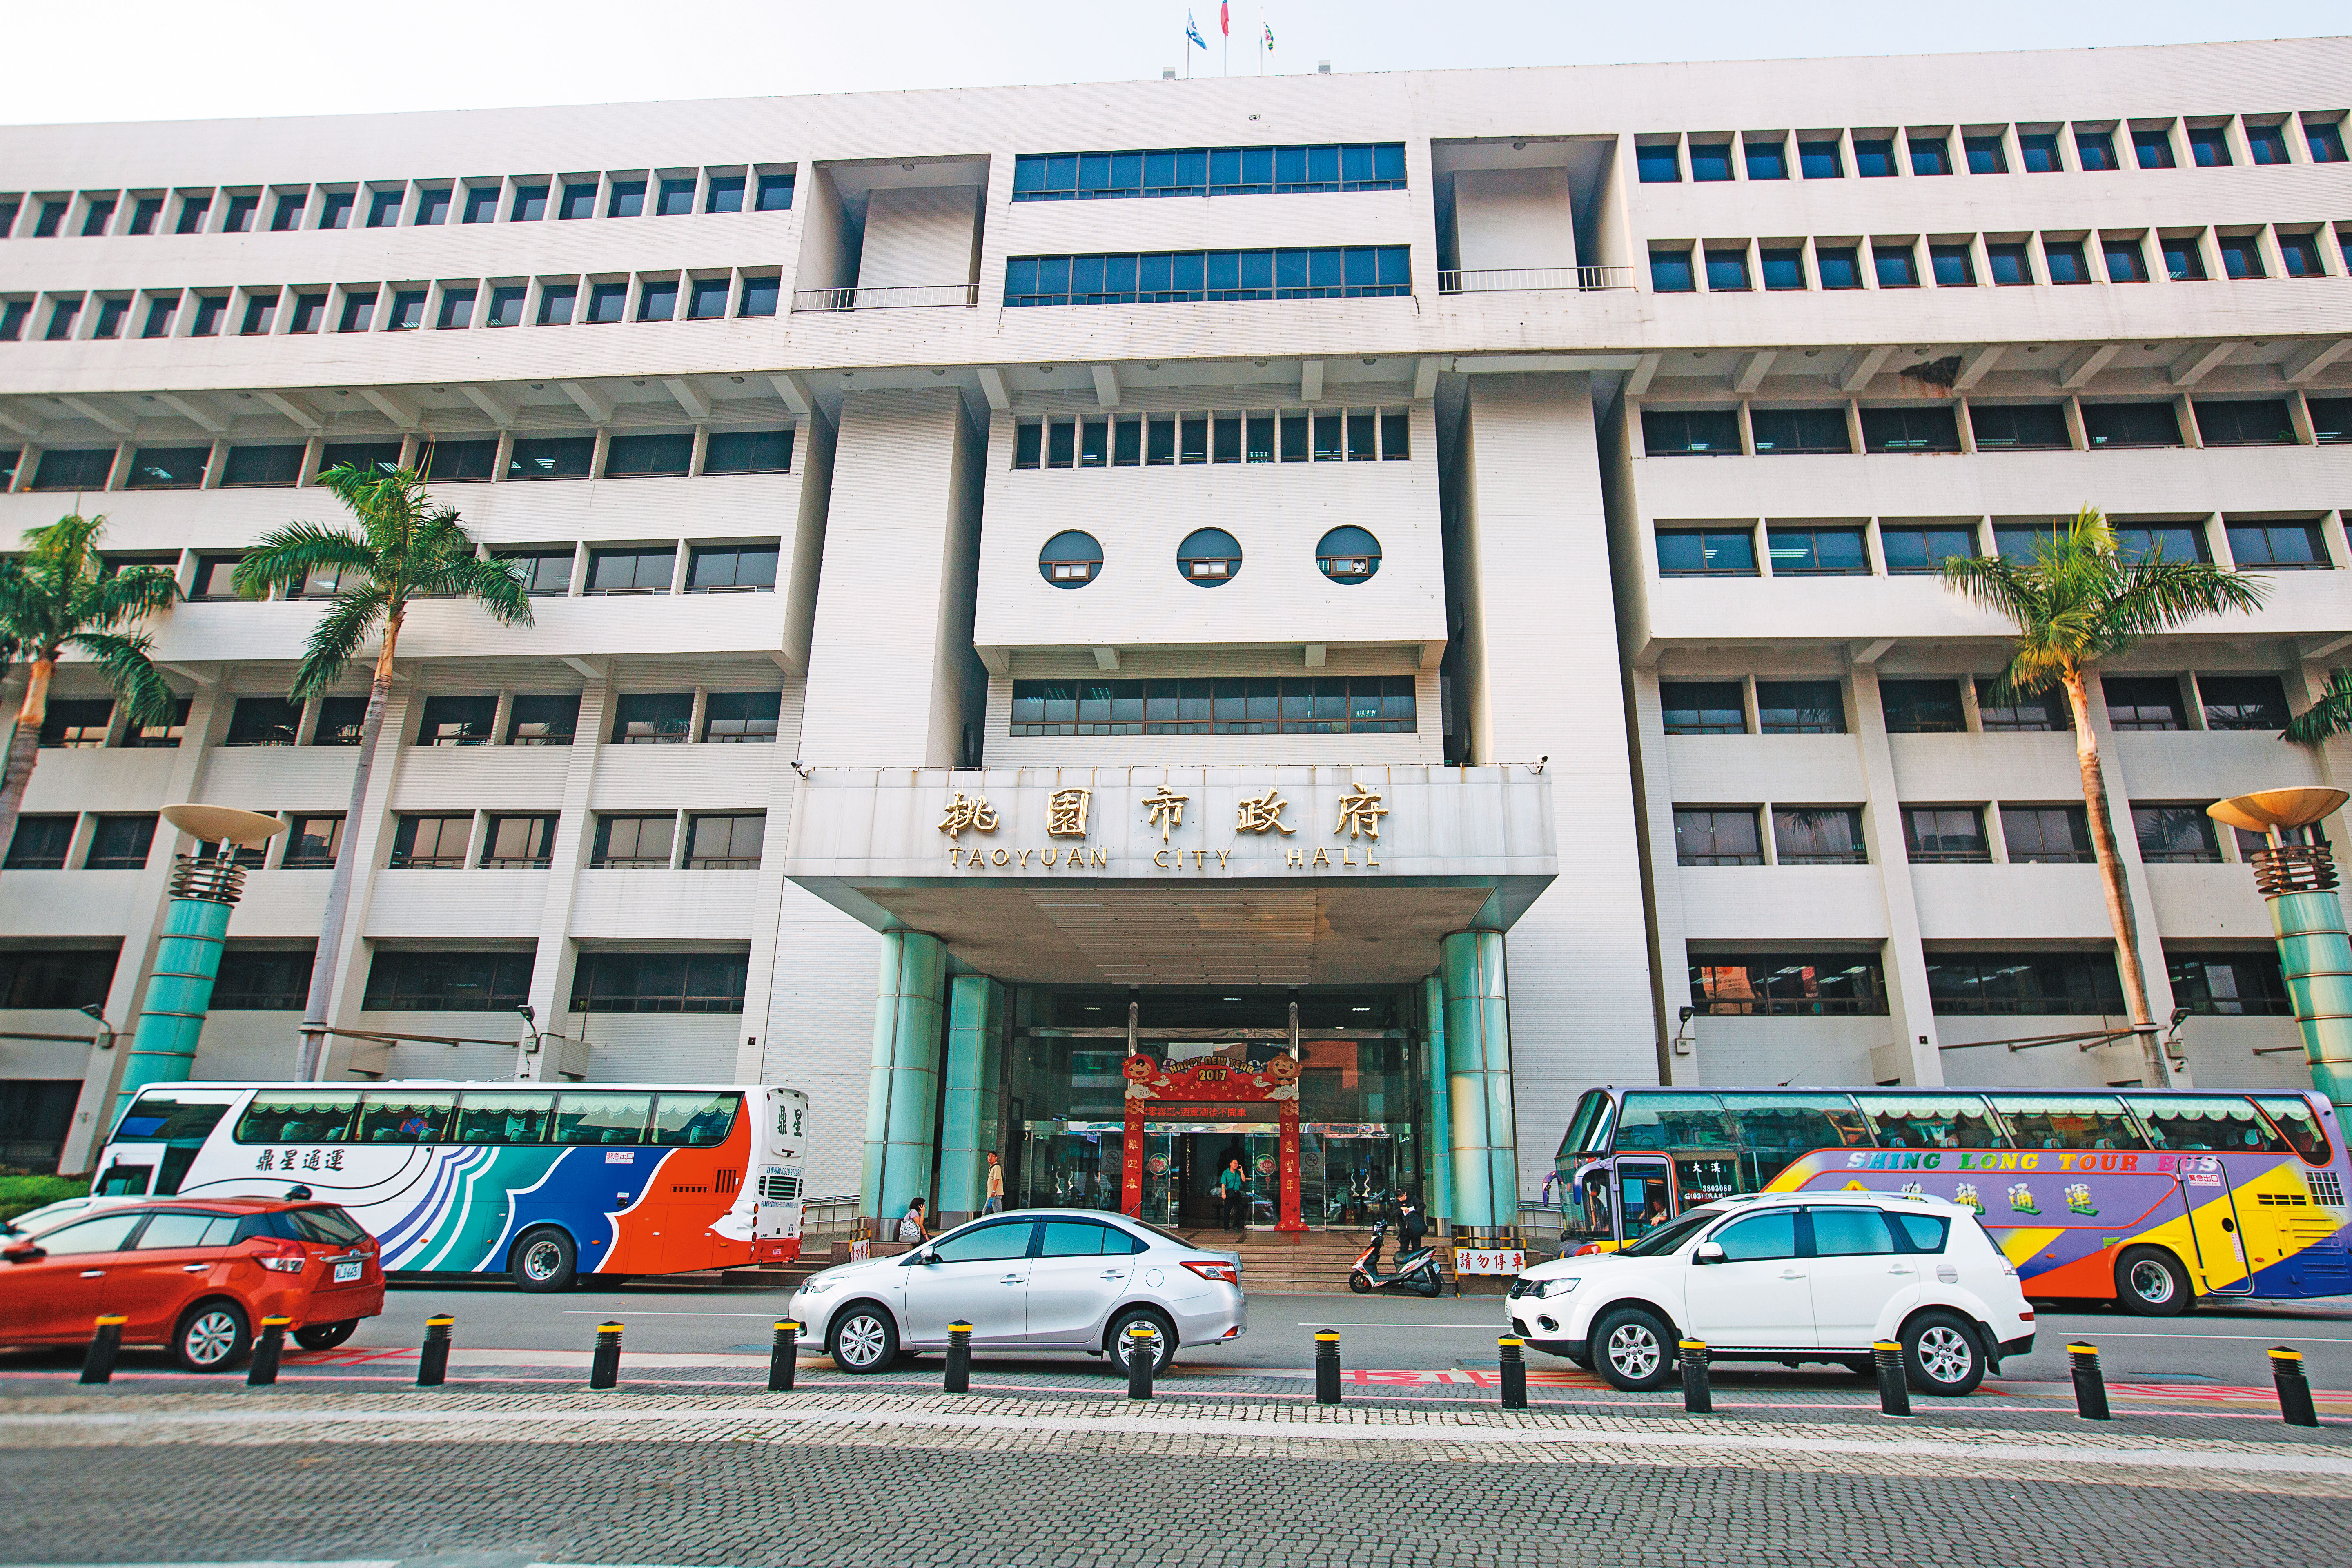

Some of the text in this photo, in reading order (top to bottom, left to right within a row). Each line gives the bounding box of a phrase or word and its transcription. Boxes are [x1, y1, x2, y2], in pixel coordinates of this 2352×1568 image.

[938, 782, 1389, 842] 桃園市政府
[948, 847, 1380, 868] TAOYUAN CITY HALL
[1169, 1056, 1203, 1075] HAPPY
[1229, 1058, 1255, 1075] YEAR
[1198, 1069, 1227, 1081] 2017
[255, 1149, 345, 1171] 鼎星通運
[1126, 1121, 1139, 1189] 金雞迎春
[1846, 1152, 2217, 1172] SHING LONG TOUR BUS
[851, 1241, 869, 1262] 請勿停車
[1459, 1252, 1523, 1272] 請勿停車
